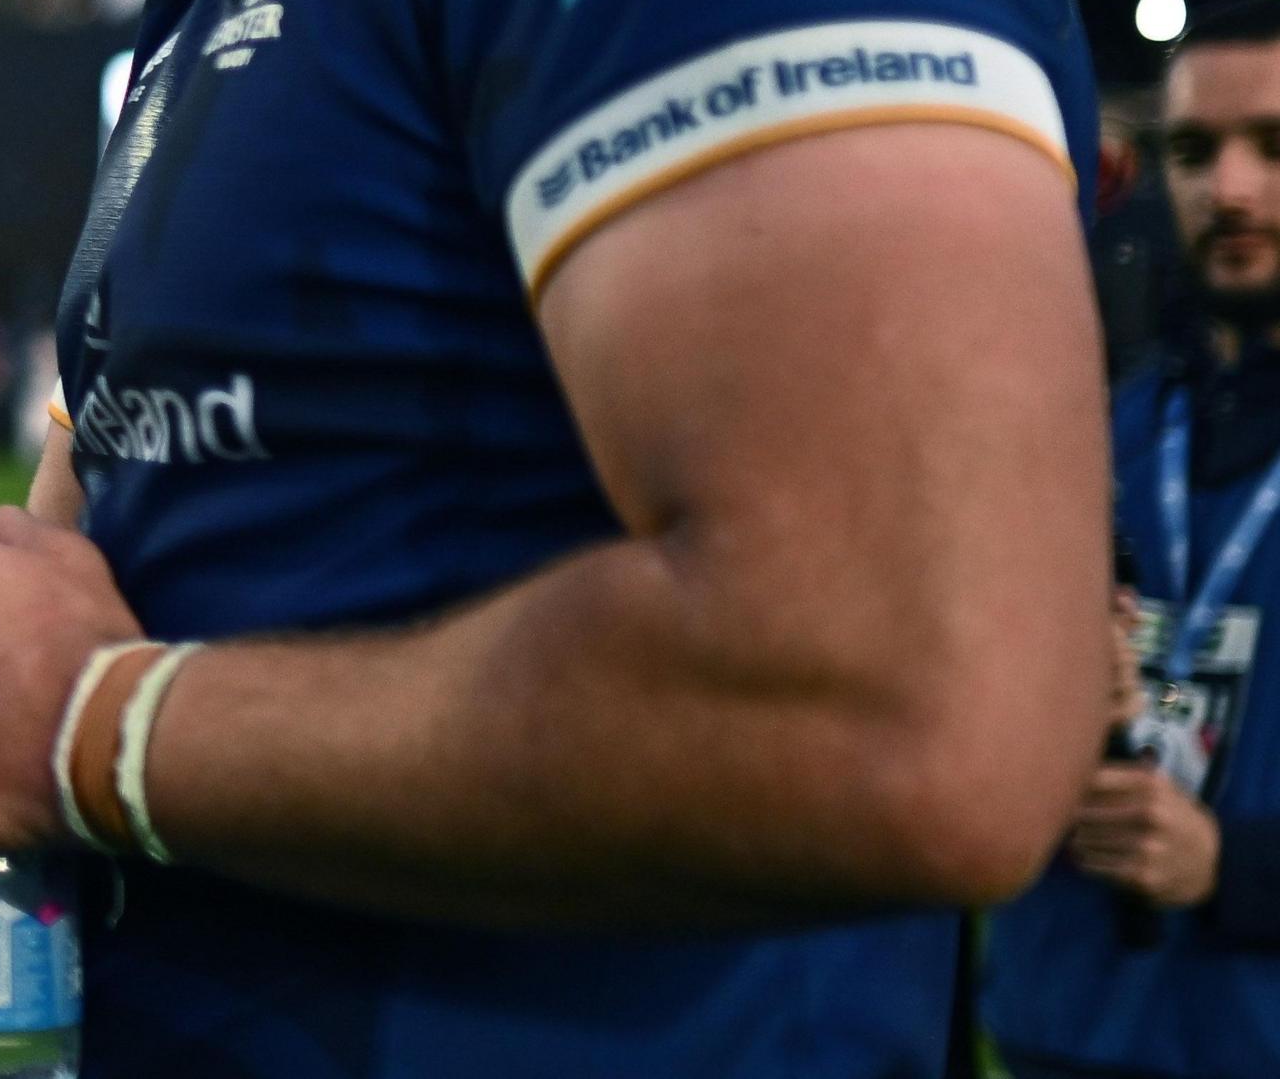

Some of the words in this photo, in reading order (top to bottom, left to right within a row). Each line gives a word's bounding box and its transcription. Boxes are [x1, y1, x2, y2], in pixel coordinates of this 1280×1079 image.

[577, 93, 697, 190] Bank
[705, 75, 761, 118] of
[775, 48, 979, 101] Ireland
